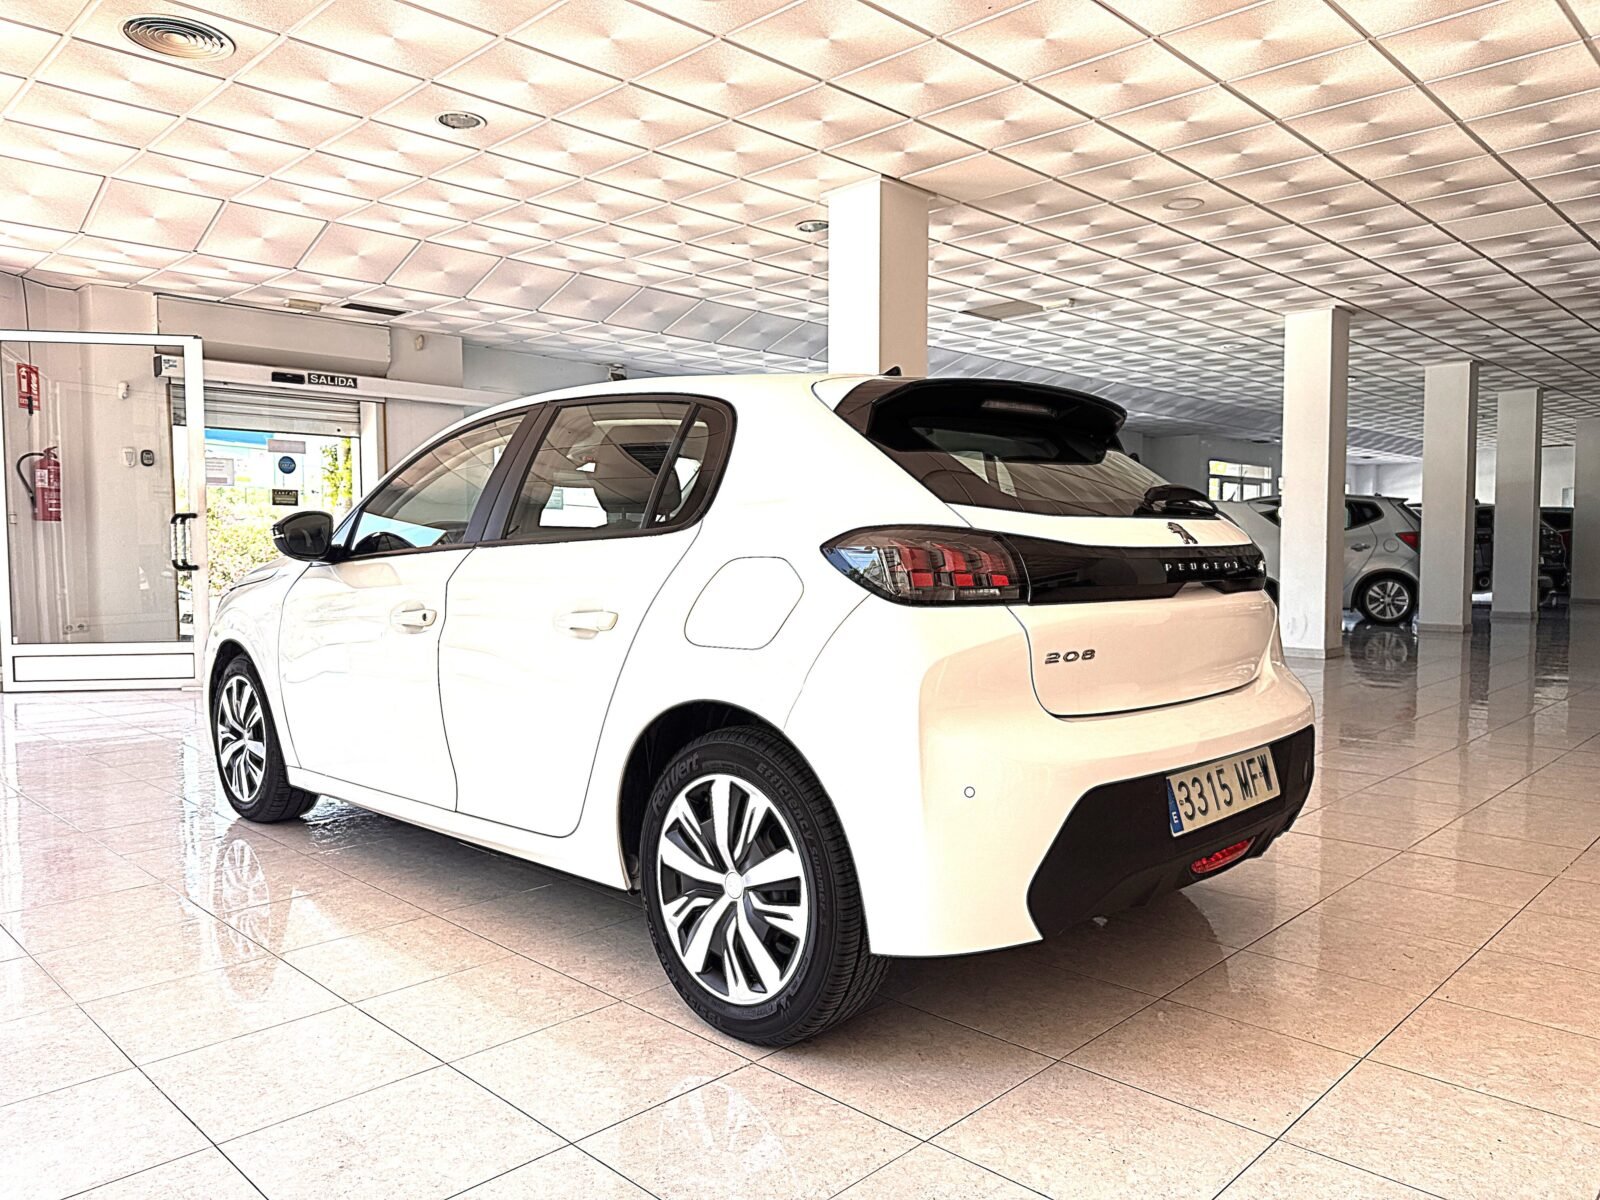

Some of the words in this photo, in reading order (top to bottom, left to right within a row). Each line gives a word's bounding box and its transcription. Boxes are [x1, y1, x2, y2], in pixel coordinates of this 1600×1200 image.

[310, 374, 355, 387] SALIDA
[1044, 649, 1096, 664] 208
[1171, 811, 1179, 824] E
[1177, 768, 1234, 821] 3315
[1234, 753, 1273, 800] MFW
